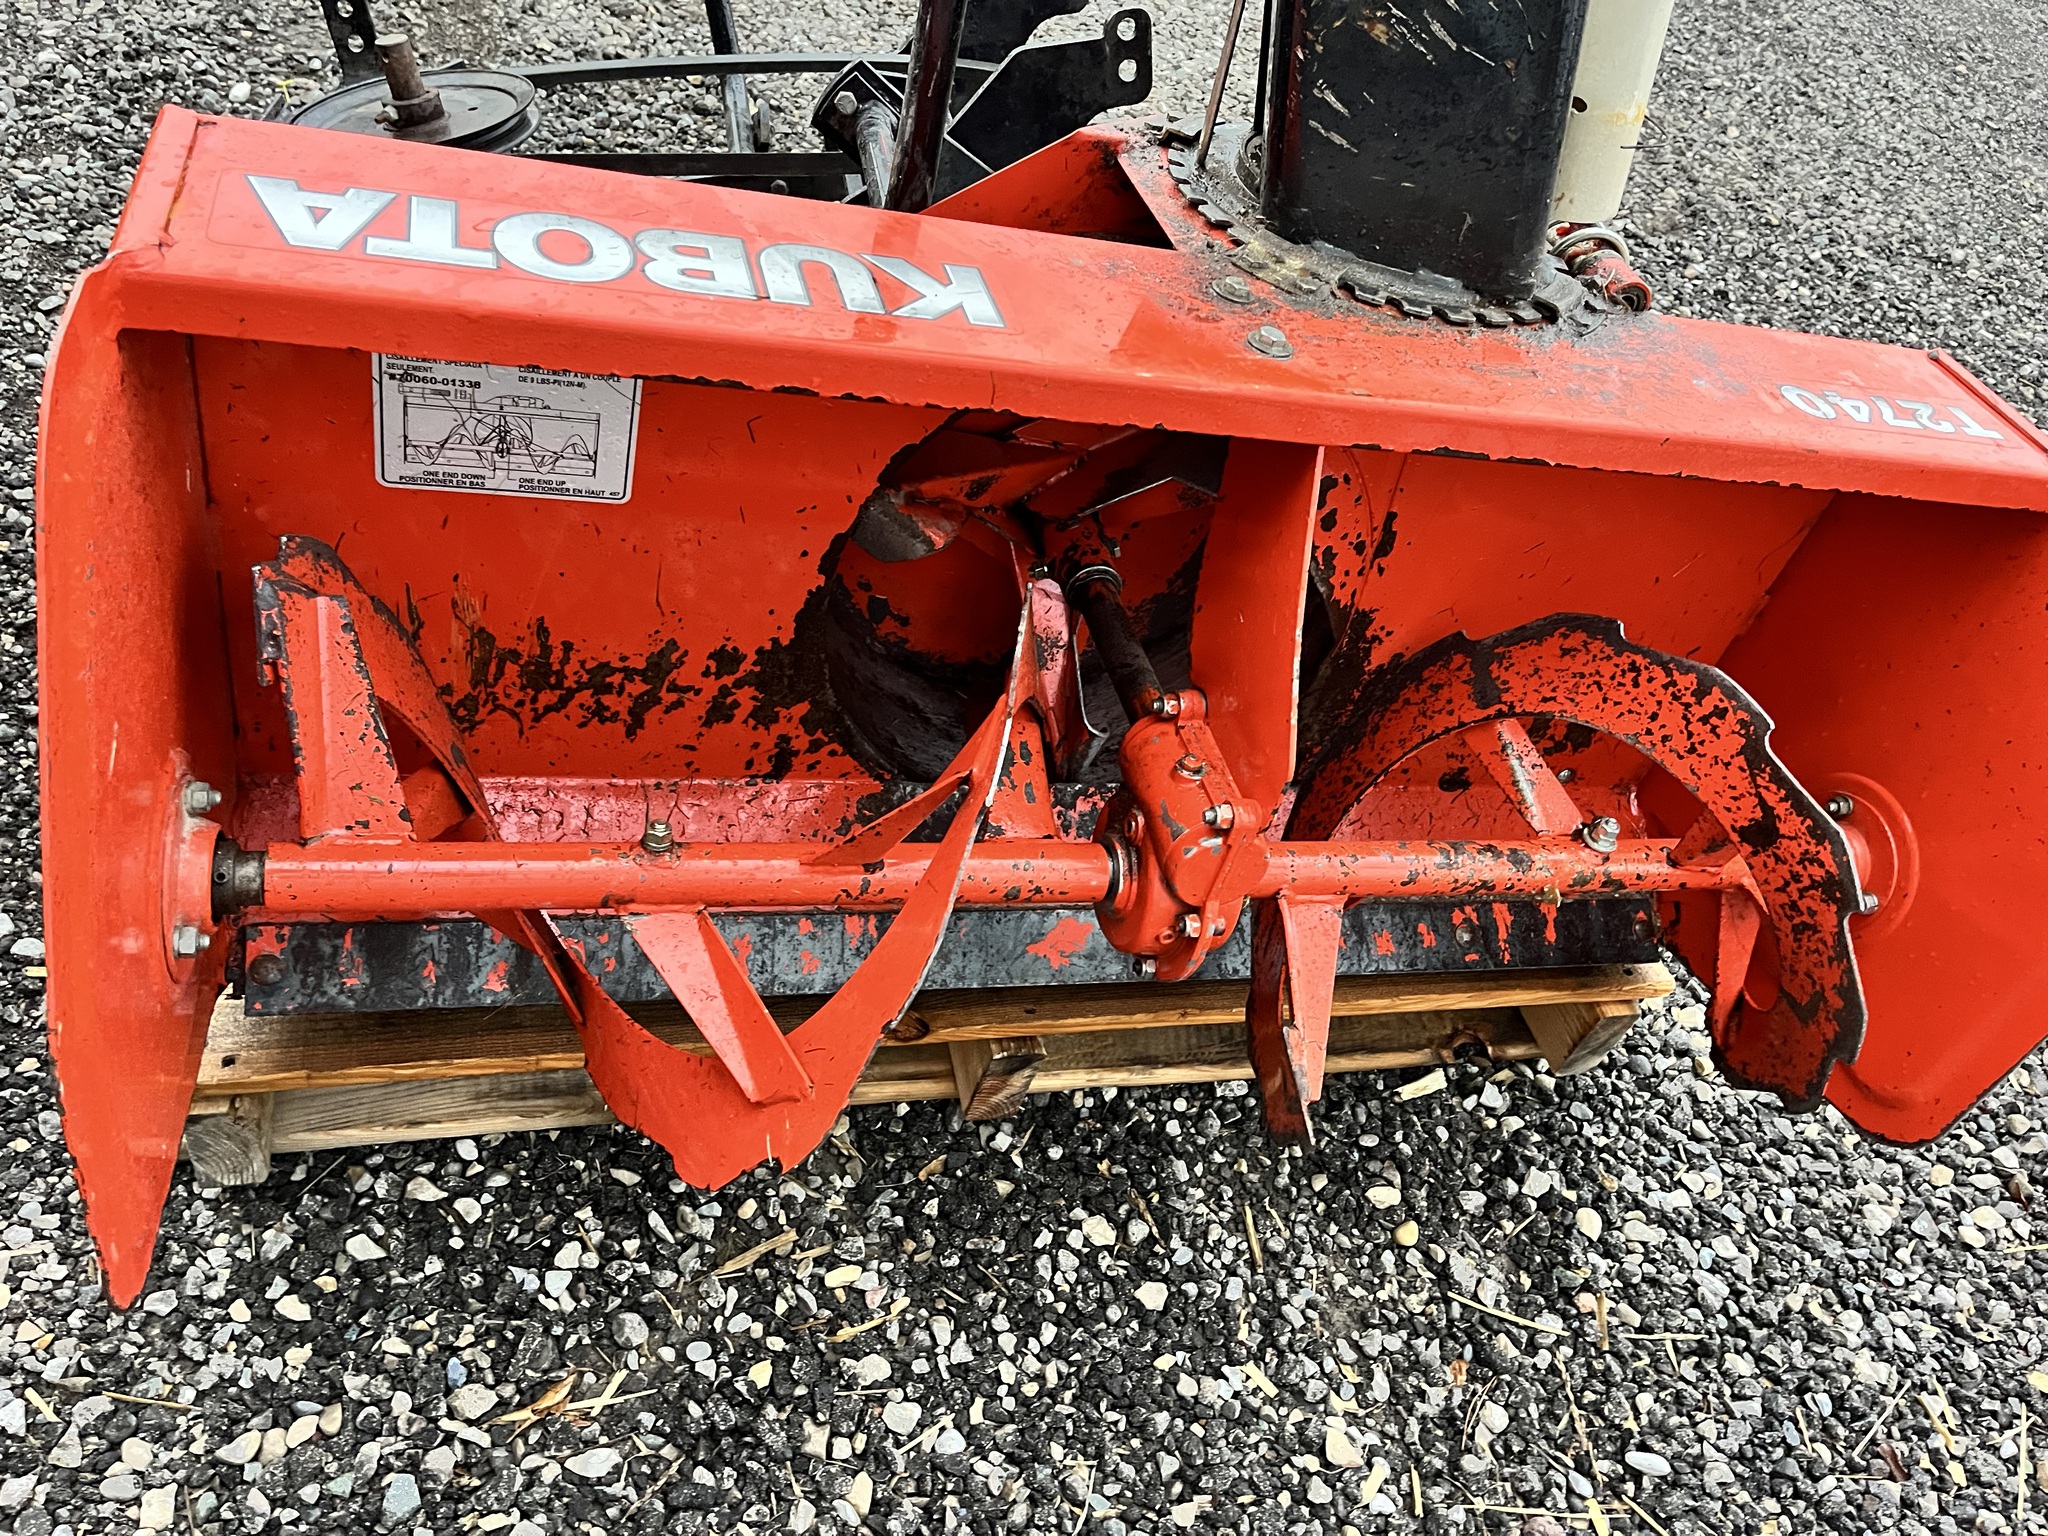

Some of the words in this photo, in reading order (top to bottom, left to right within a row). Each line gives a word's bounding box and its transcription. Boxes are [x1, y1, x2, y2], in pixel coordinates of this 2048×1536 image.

[244, 174, 1006, 328] KUBOTA
[1778, 384, 2005, 440] T2740
[400, 476, 454, 486] POSITIONNER
[518, 484, 570, 494] POSITIONNER
